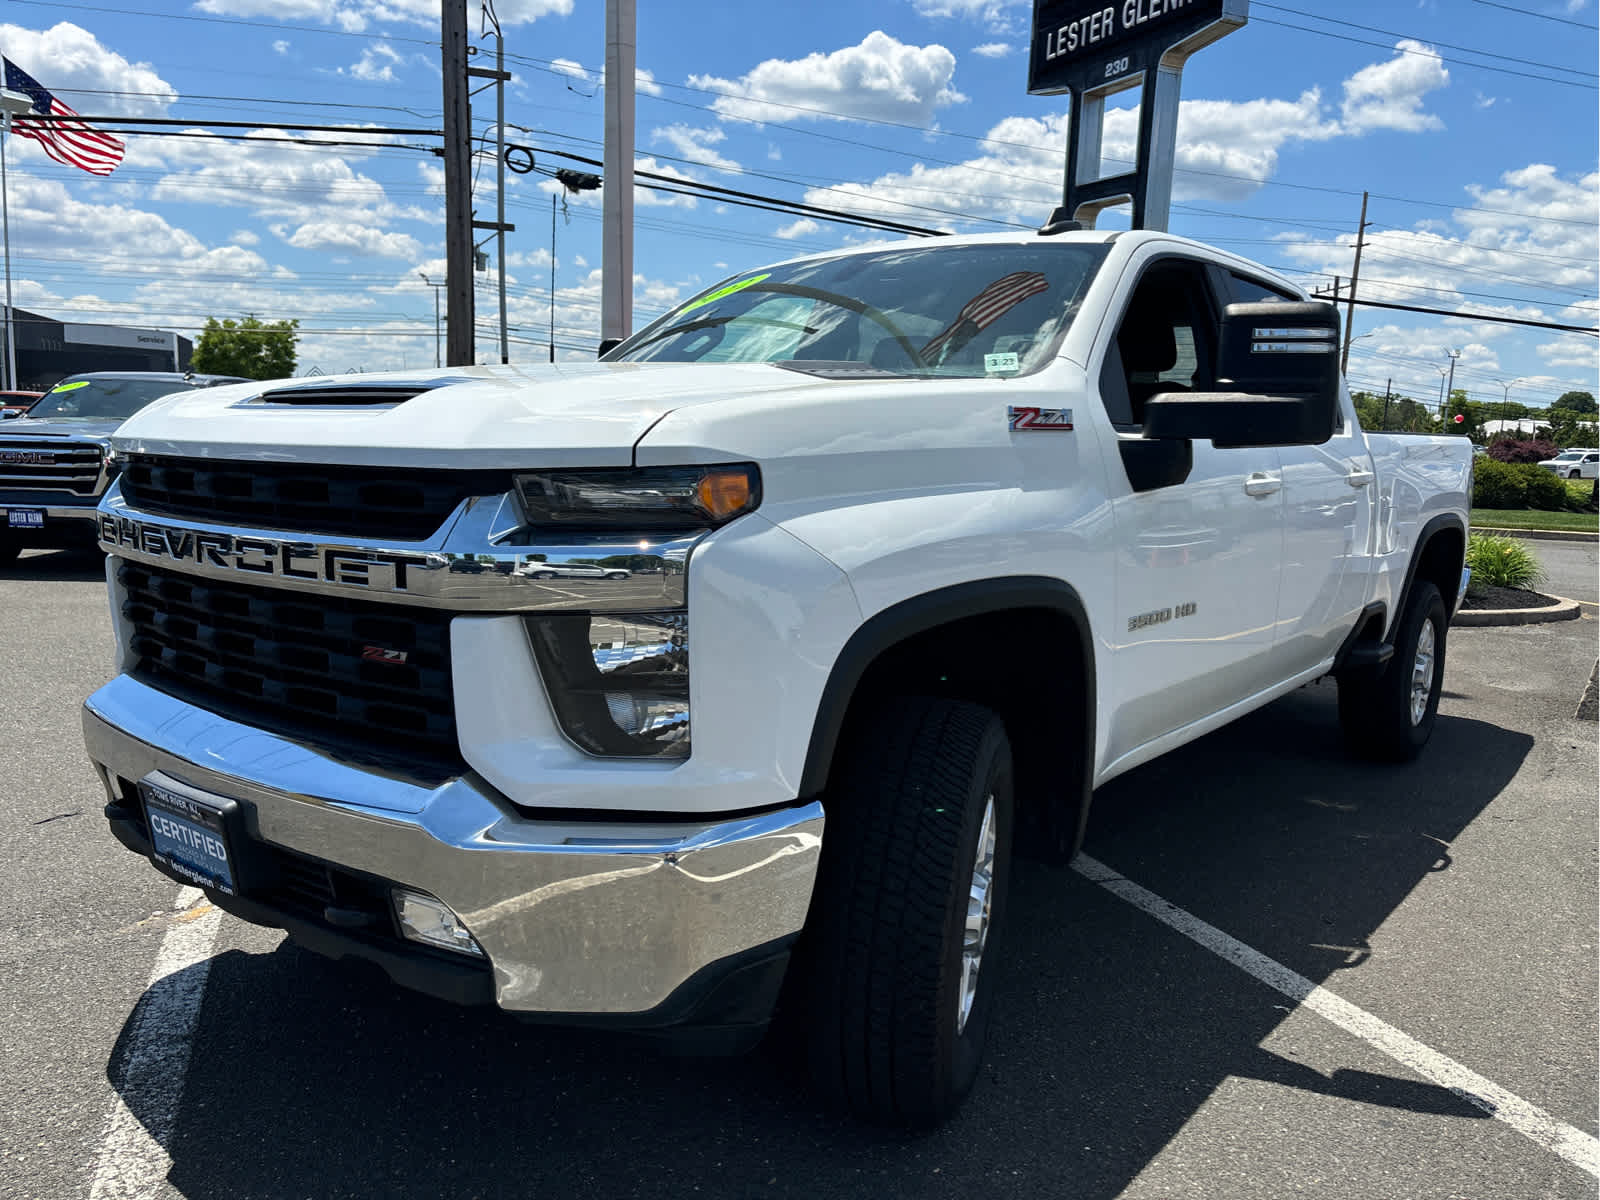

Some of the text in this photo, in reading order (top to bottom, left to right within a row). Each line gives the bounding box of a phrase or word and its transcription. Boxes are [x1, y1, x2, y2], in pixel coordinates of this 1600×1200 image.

[1046, 0, 1193, 61] LESTER GLE
[1105, 57, 1129, 77] 230
[137, 335, 165, 345] Service
[99, 514, 428, 592] CHEVROLET
[151, 814, 228, 861] CERTIFIED
